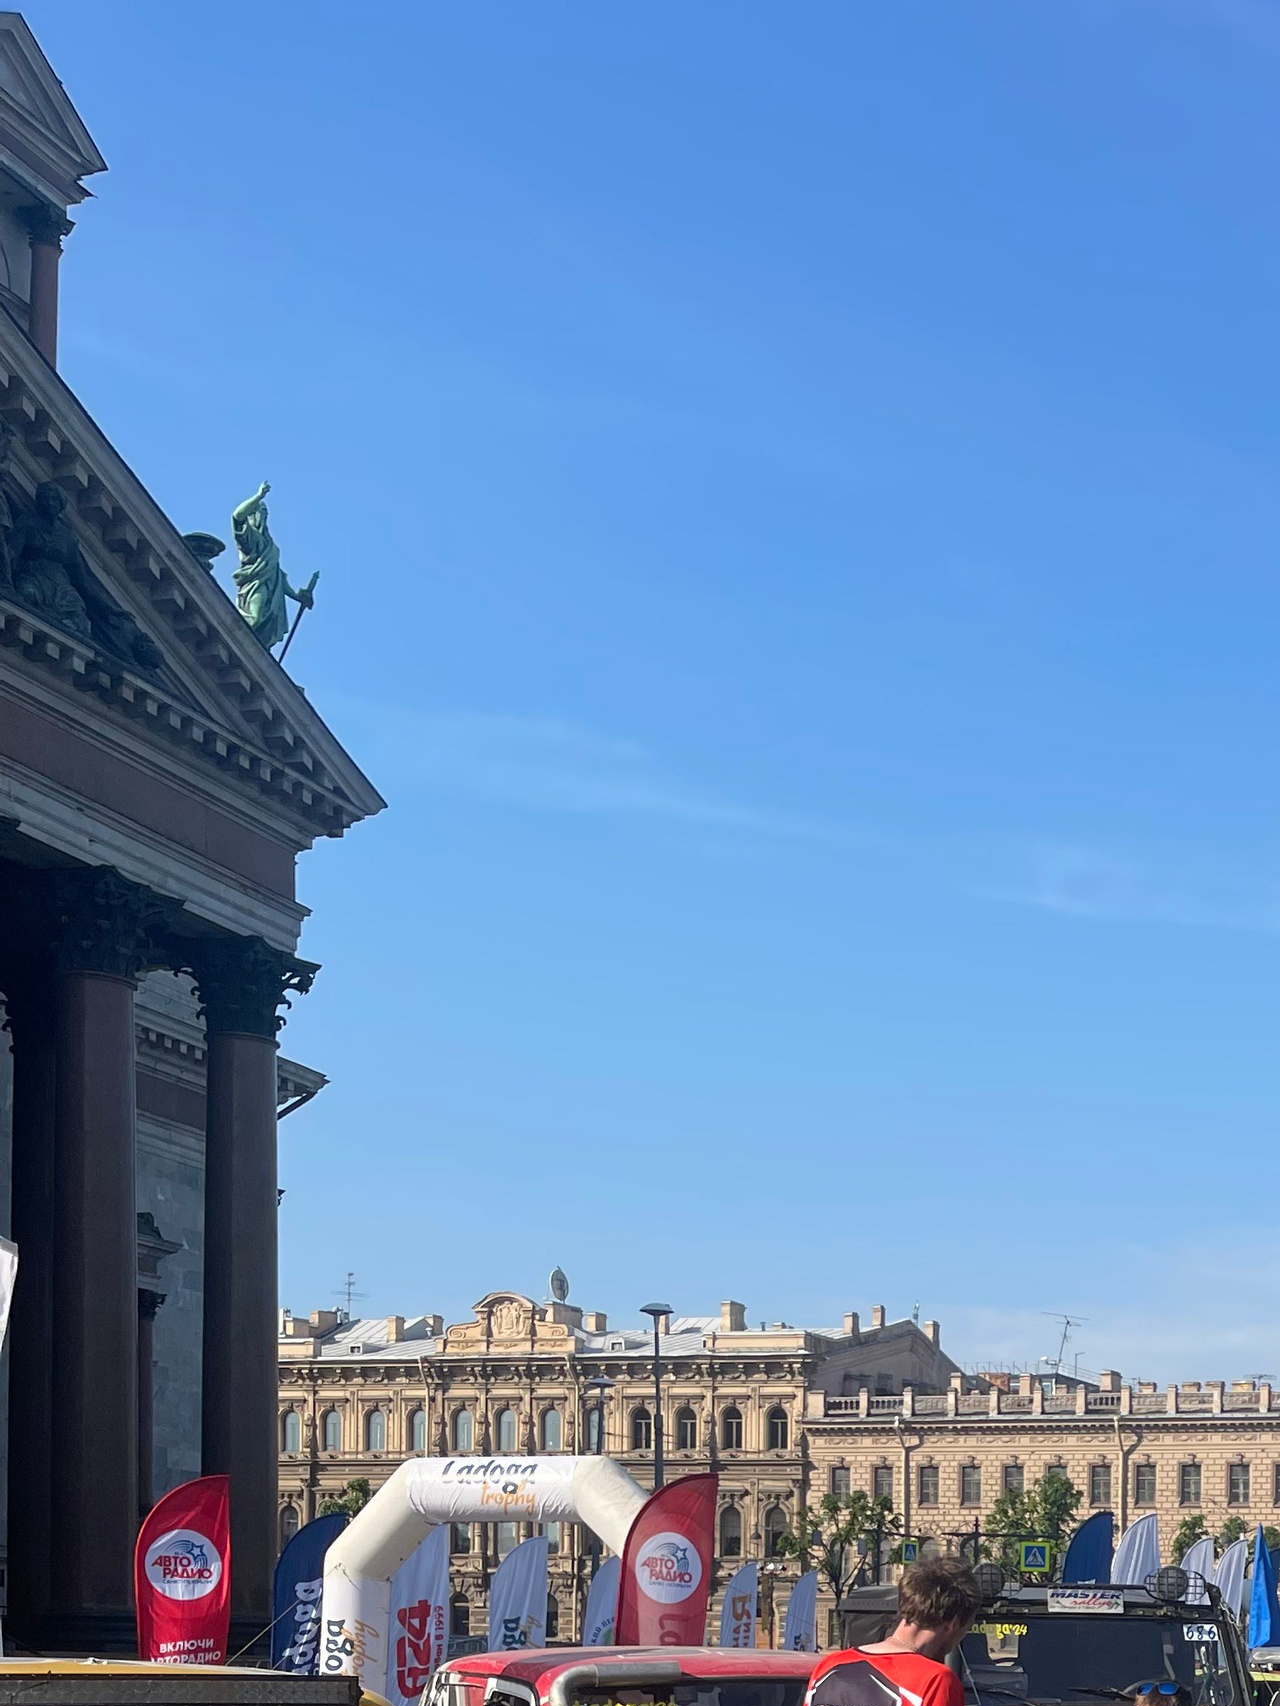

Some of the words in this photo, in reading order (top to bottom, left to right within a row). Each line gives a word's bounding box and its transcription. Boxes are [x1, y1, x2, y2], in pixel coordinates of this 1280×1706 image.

[441, 1460, 538, 1494] Ladoga
[480, 1480, 536, 1515] trophy
[151, 1555, 191, 1567] АВТО
[641, 1556, 675, 1569] АВТО
[163, 1567, 213, 1580] РАДИО
[649, 1569, 693, 1583] РАДИО
[1187, 1625, 1216, 1640] 686
[160, 1639, 214, 1653] ВКЛЮЧИ
